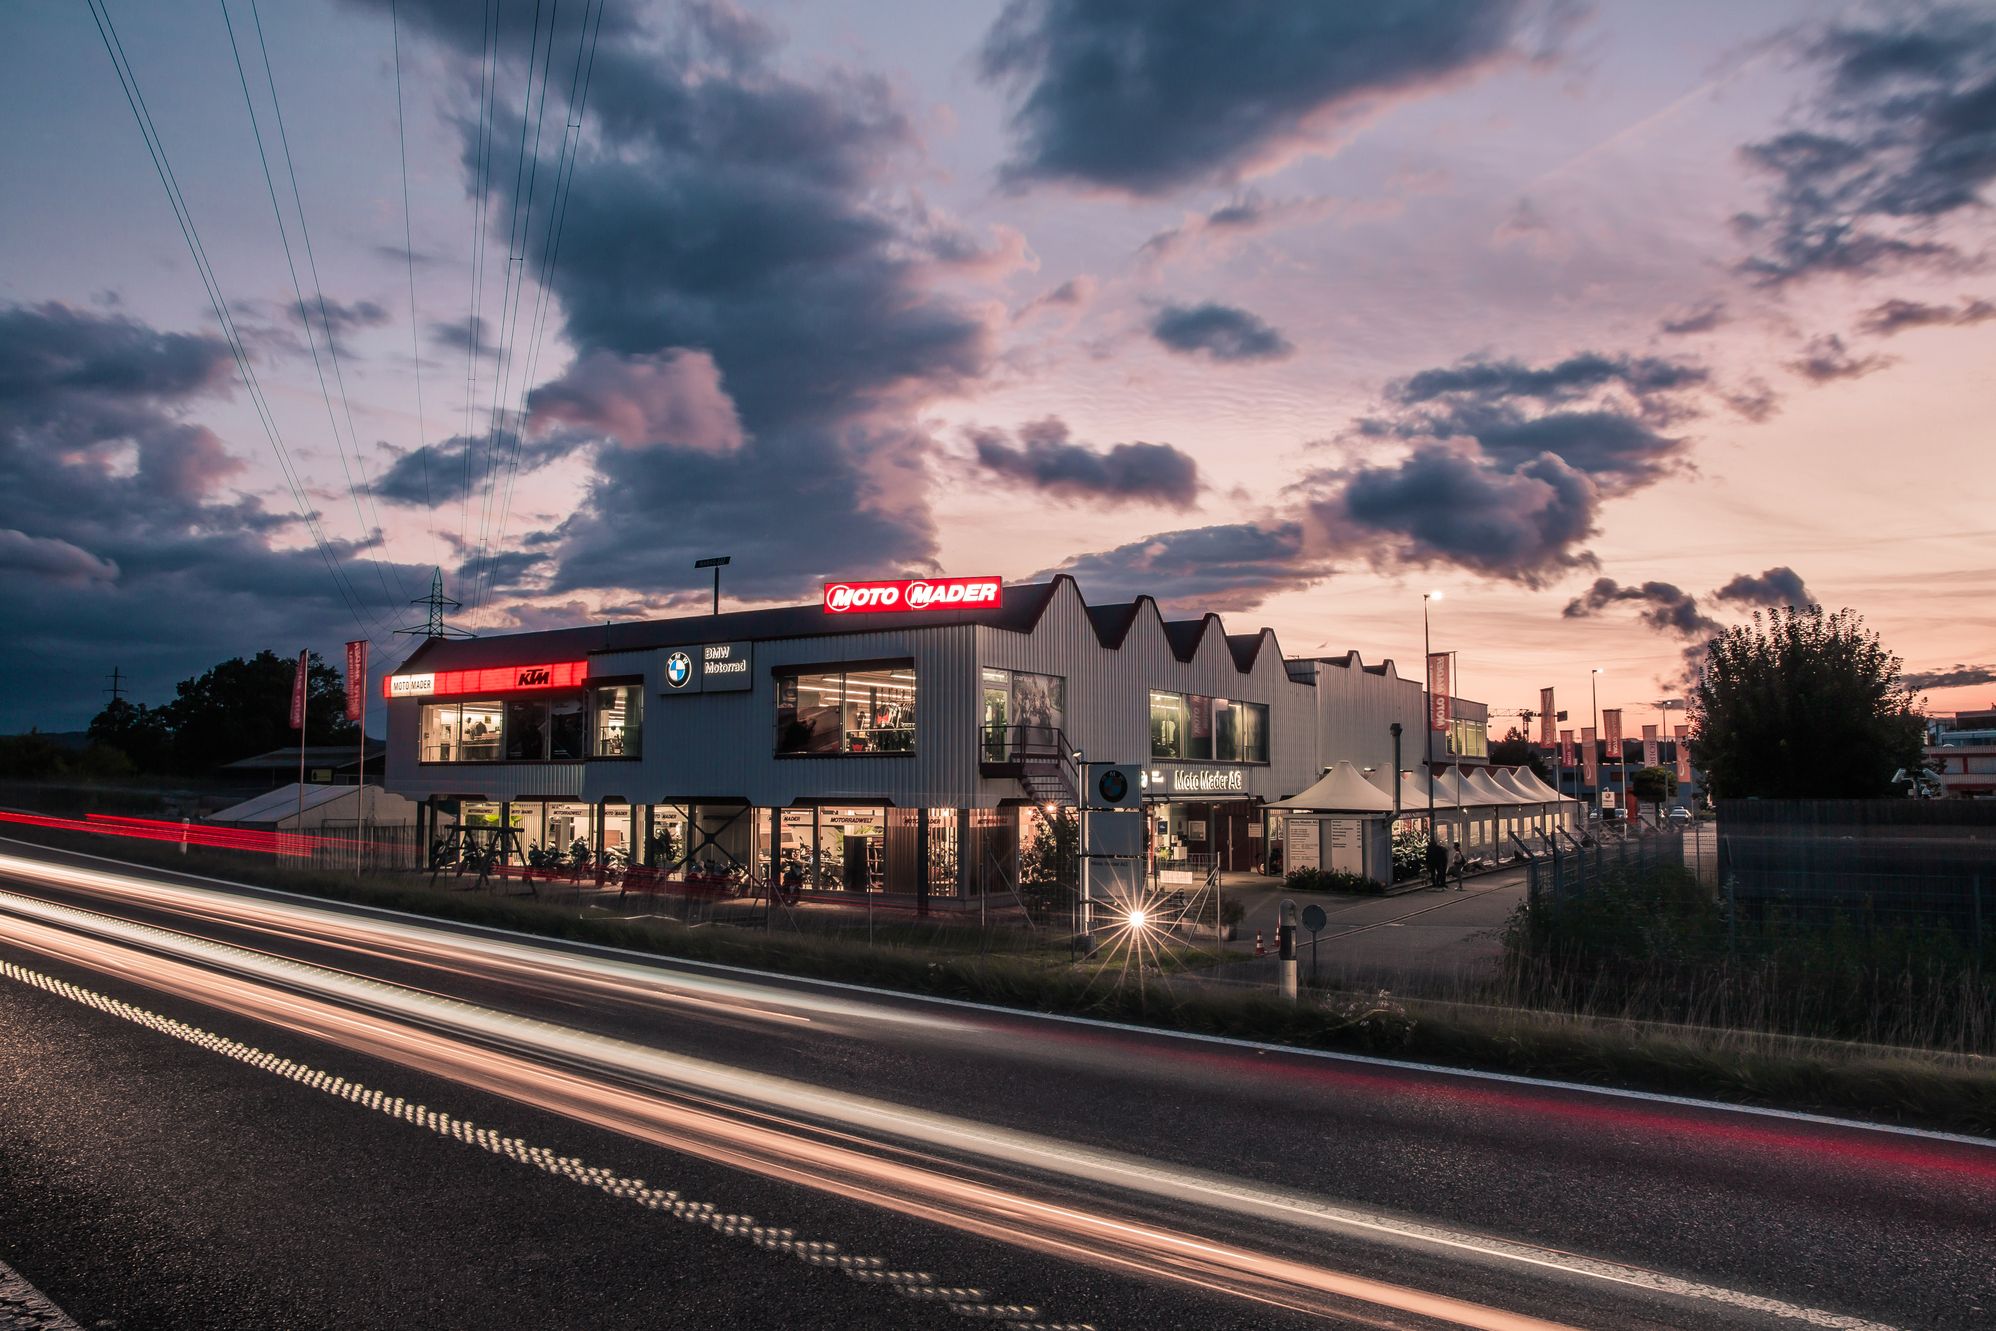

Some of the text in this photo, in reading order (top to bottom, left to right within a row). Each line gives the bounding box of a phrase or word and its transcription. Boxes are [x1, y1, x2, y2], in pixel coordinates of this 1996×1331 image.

[831, 583, 998, 607] MOTO MADER
[704, 646, 730, 660] BMW
[704, 659, 746, 674] Motorrad
[393, 679, 431, 691] MOTO MADER
[518, 668, 550, 686] KTM
[1175, 770, 1199, 790] Moto
[1200, 770, 1228, 790] Mader
[1228, 770, 1242, 790] AG
